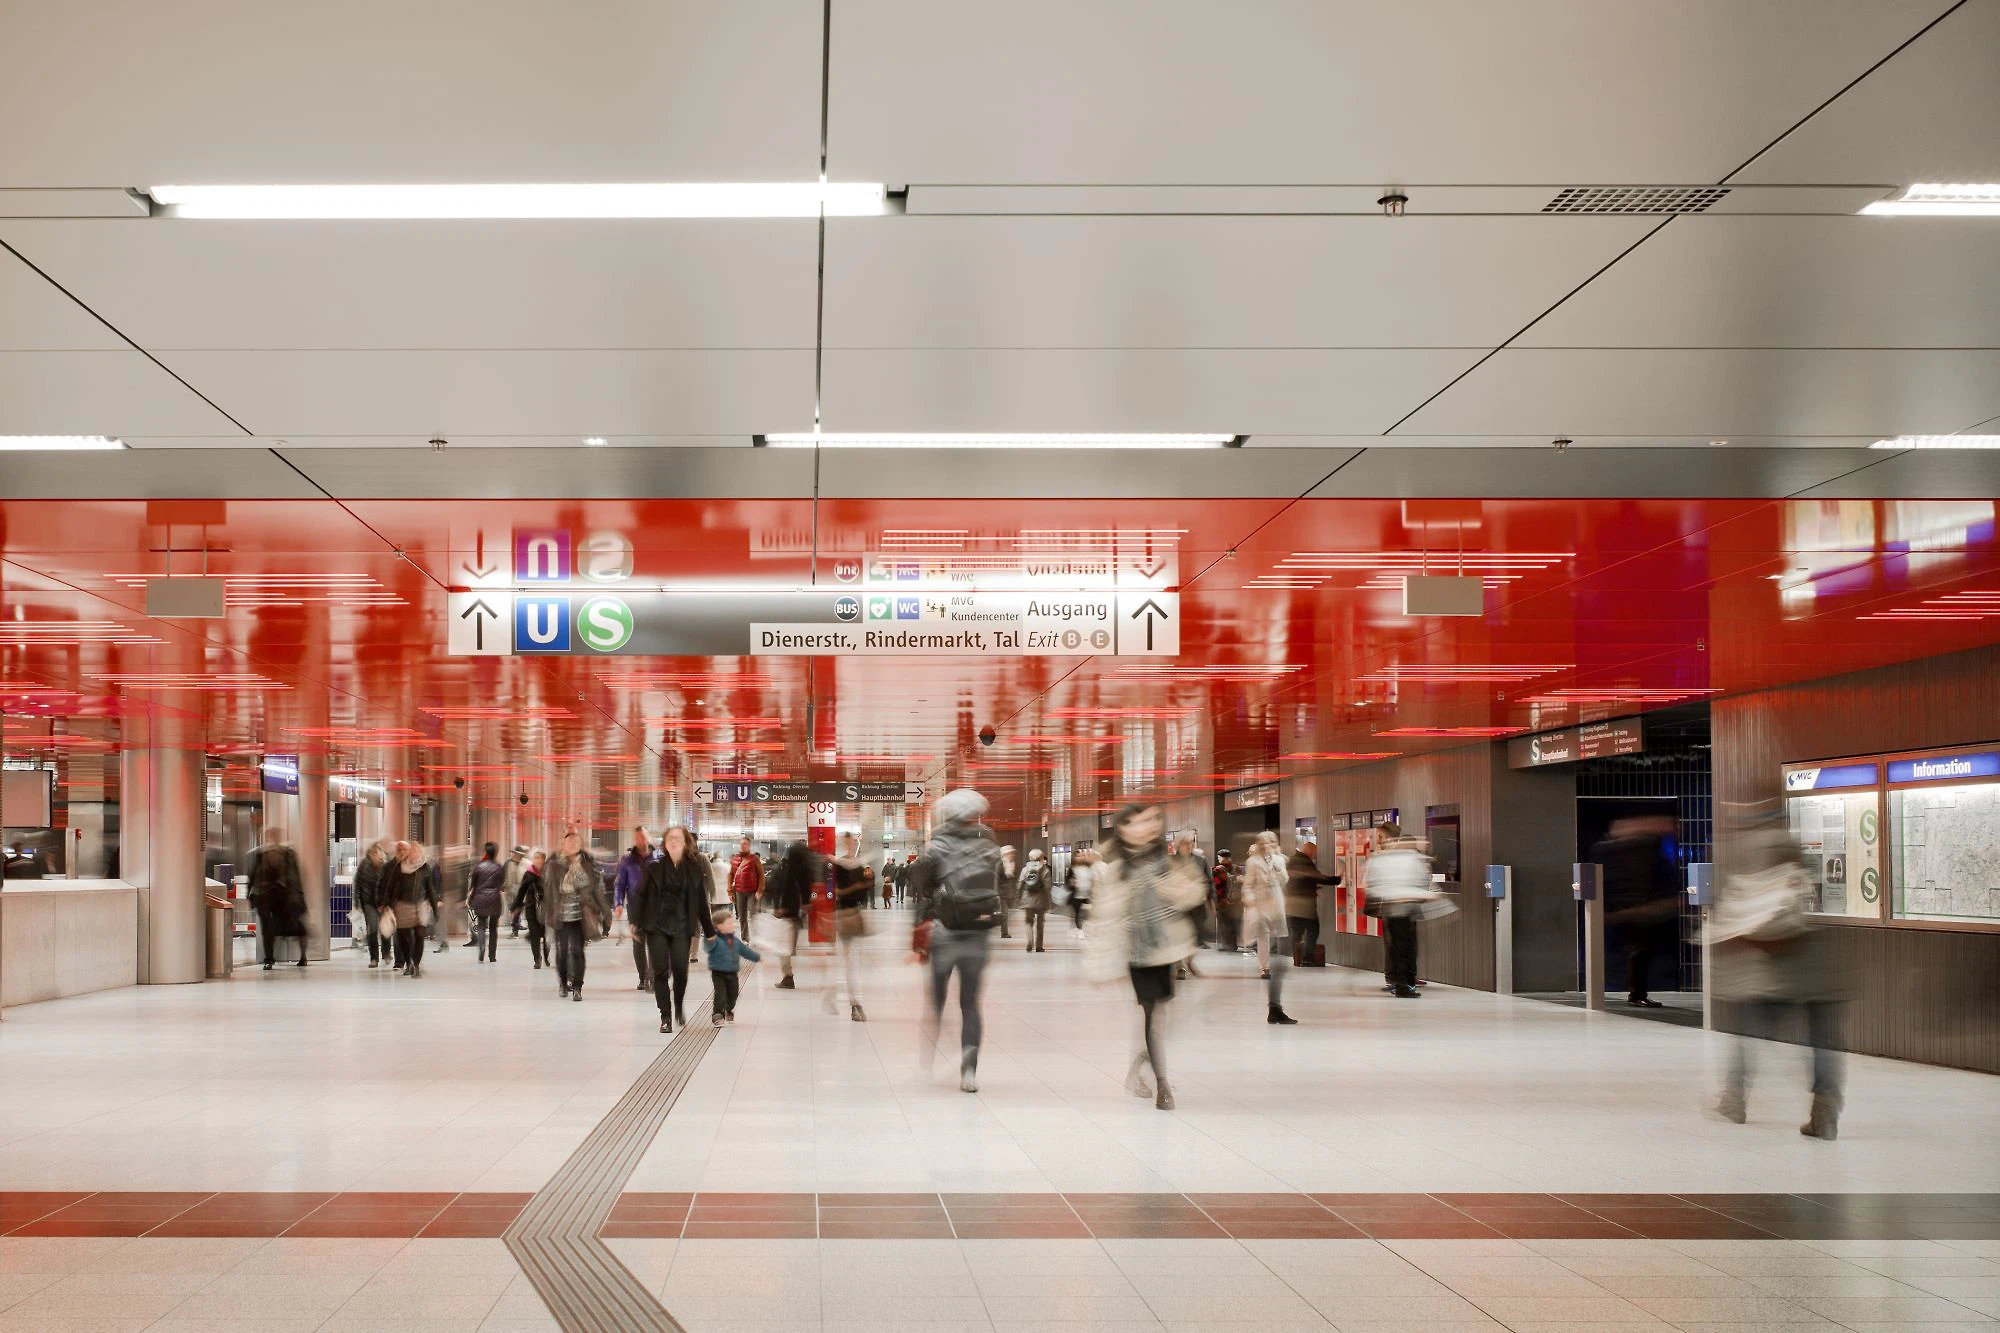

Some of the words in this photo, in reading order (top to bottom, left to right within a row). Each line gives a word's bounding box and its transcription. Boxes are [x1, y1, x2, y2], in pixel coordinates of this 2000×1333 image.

[835, 604, 859, 614] BUS
[898, 603, 919, 614] WC
[951, 596, 974, 606] MVG
[951, 611, 1019, 621] Kundencenter
[1027, 600, 1108, 620] Ausgang
[527, 604, 559, 643] U
[588, 600, 623, 645] S
[762, 631, 856, 650] Dienerstr.,
[865, 631, 987, 650] Rindermarkt,
[993, 631, 1019, 648] Tal
[1028, 631, 1059, 648] Exit
[1531, 739, 1540, 760] S
[1913, 758, 1971, 778] Information
[737, 786, 749, 800] U
[757, 785, 770, 801] S
[845, 785, 859, 801] S
[861, 794, 905, 802] Hauptbahnhof
[808, 801, 835, 814] SOS
